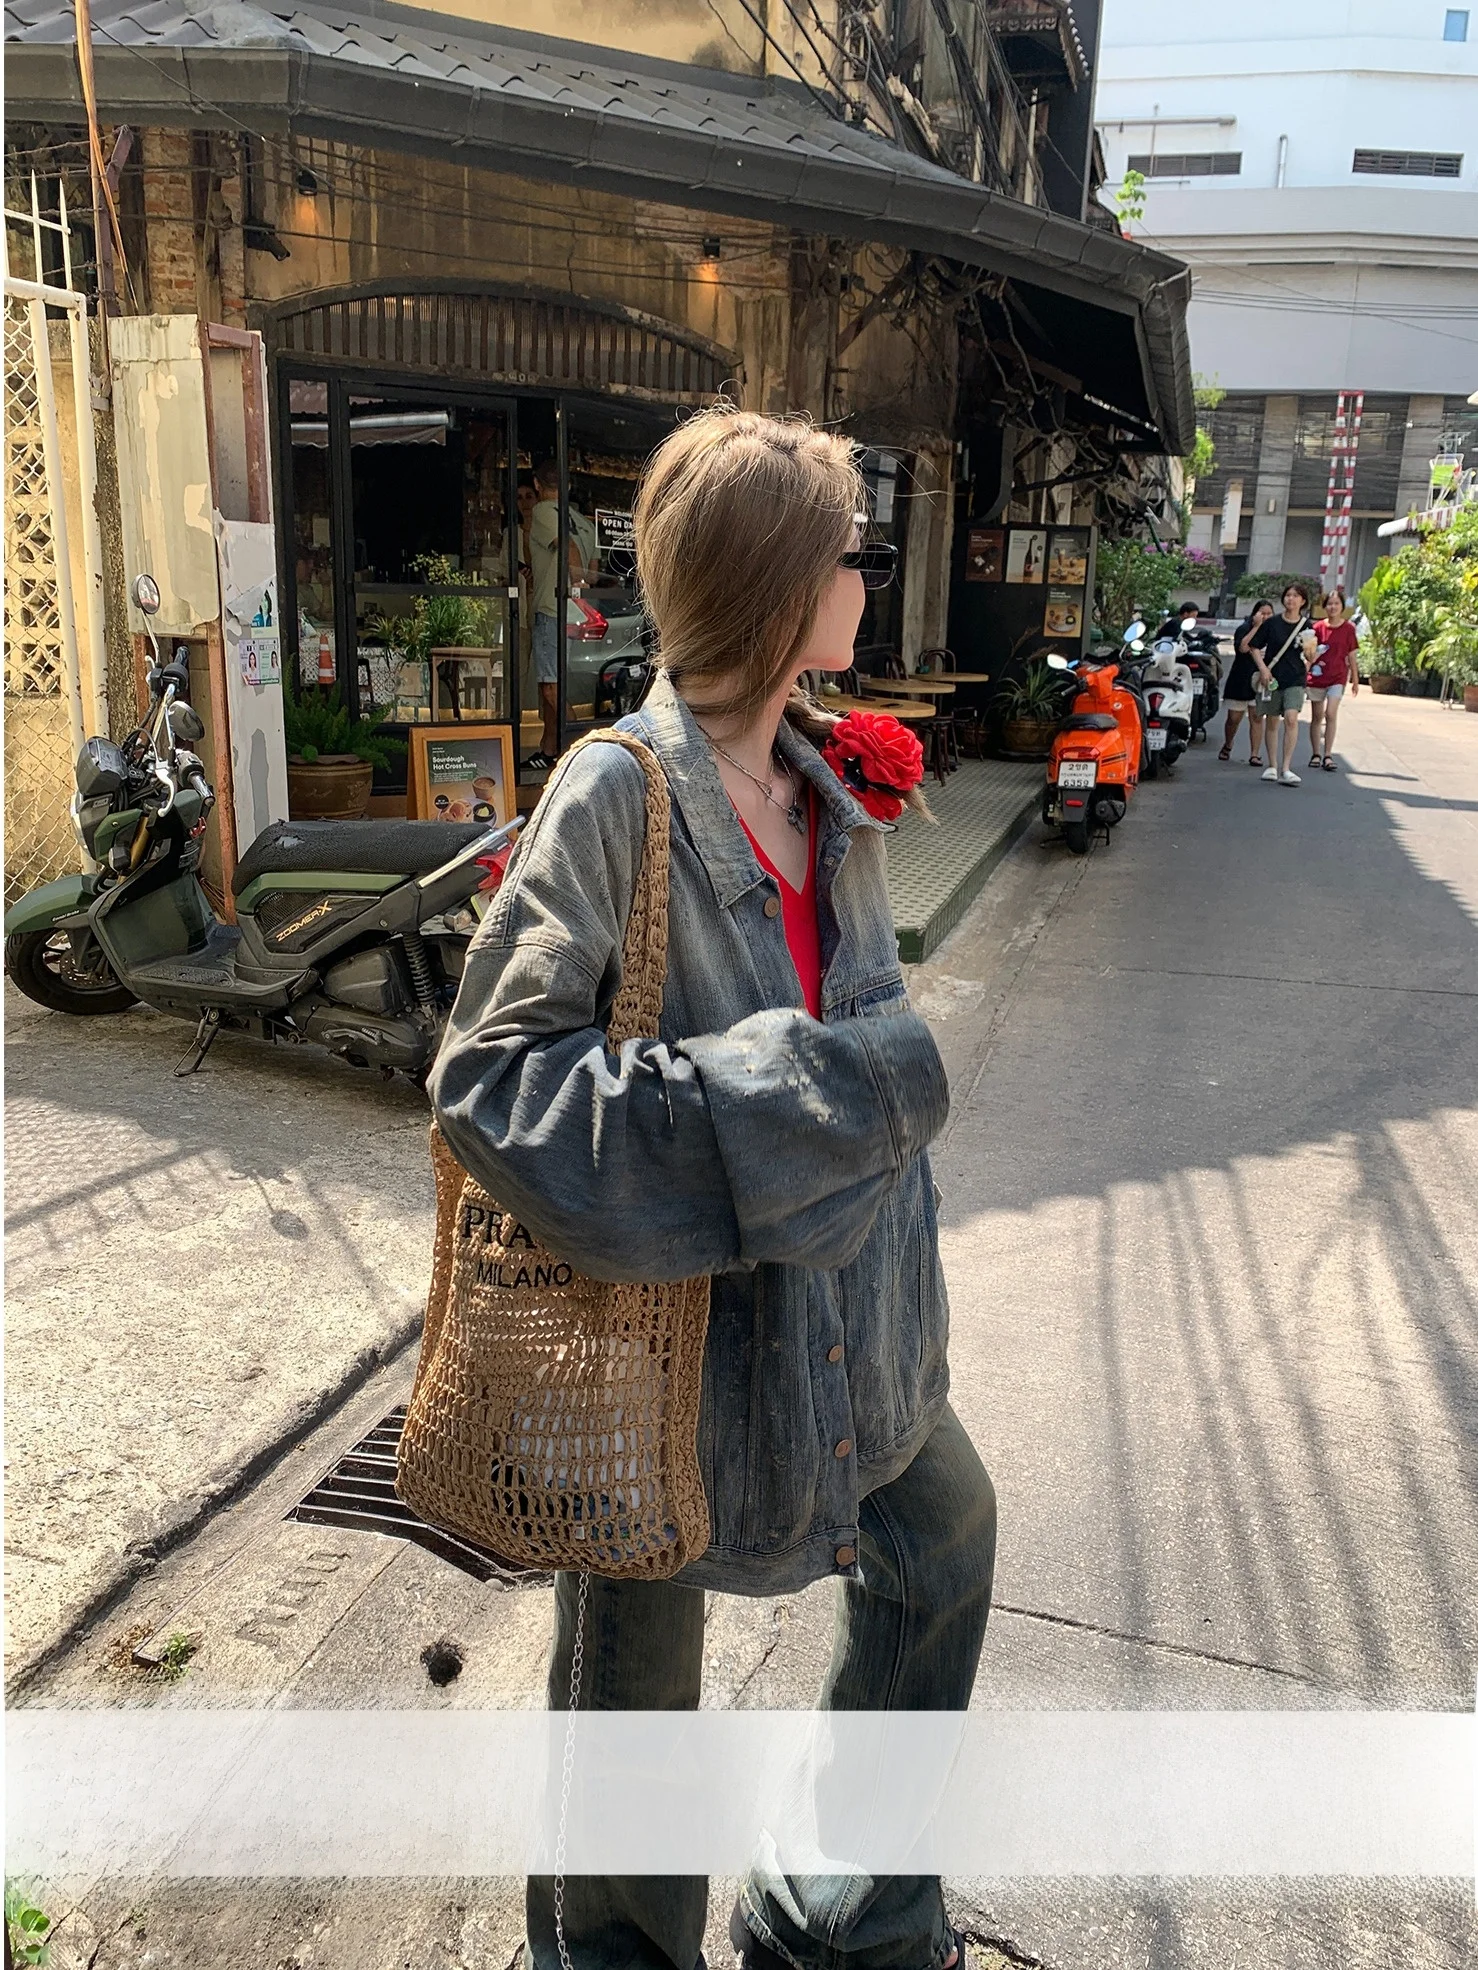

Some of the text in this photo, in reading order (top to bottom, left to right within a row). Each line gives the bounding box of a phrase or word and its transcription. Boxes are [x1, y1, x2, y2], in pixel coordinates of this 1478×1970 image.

[602, 518, 634, 529] OPEN DA
[1063, 779, 1089, 788] 6359
[462, 1204, 537, 1249] PRA
[477, 1260, 573, 1289] MILANO
